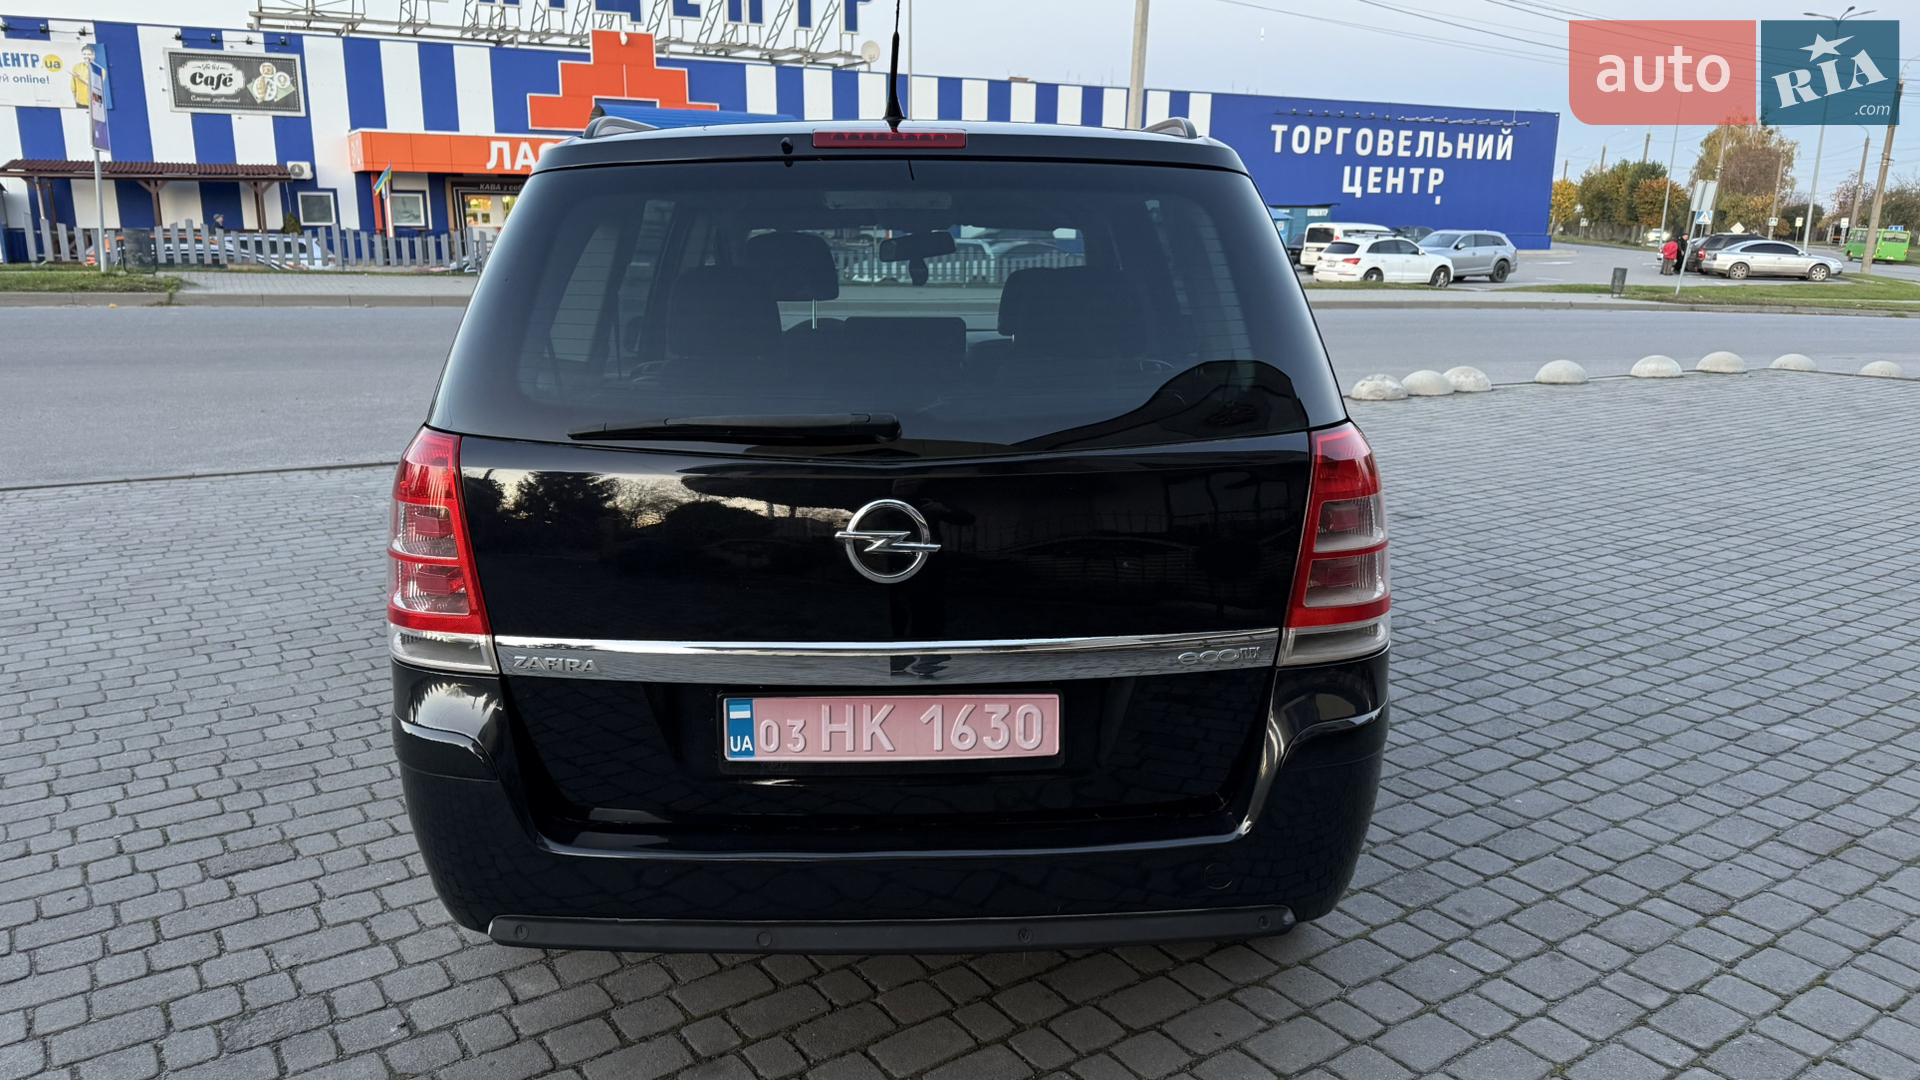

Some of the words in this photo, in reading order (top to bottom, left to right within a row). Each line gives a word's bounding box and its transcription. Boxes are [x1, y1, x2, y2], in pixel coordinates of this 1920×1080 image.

[12, 74, 50, 84] online!
[190, 71, 233, 91] Café
[1271, 124, 1514, 161] ТОРГОВЕЛЬНИЙ
[1342, 166, 1445, 198] ЦЕНТР
[513, 655, 600, 673] ZAFIRA
[730, 735, 753, 752] UA
[759, 719, 807, 753] 03
[920, 704, 1044, 751] 1630
